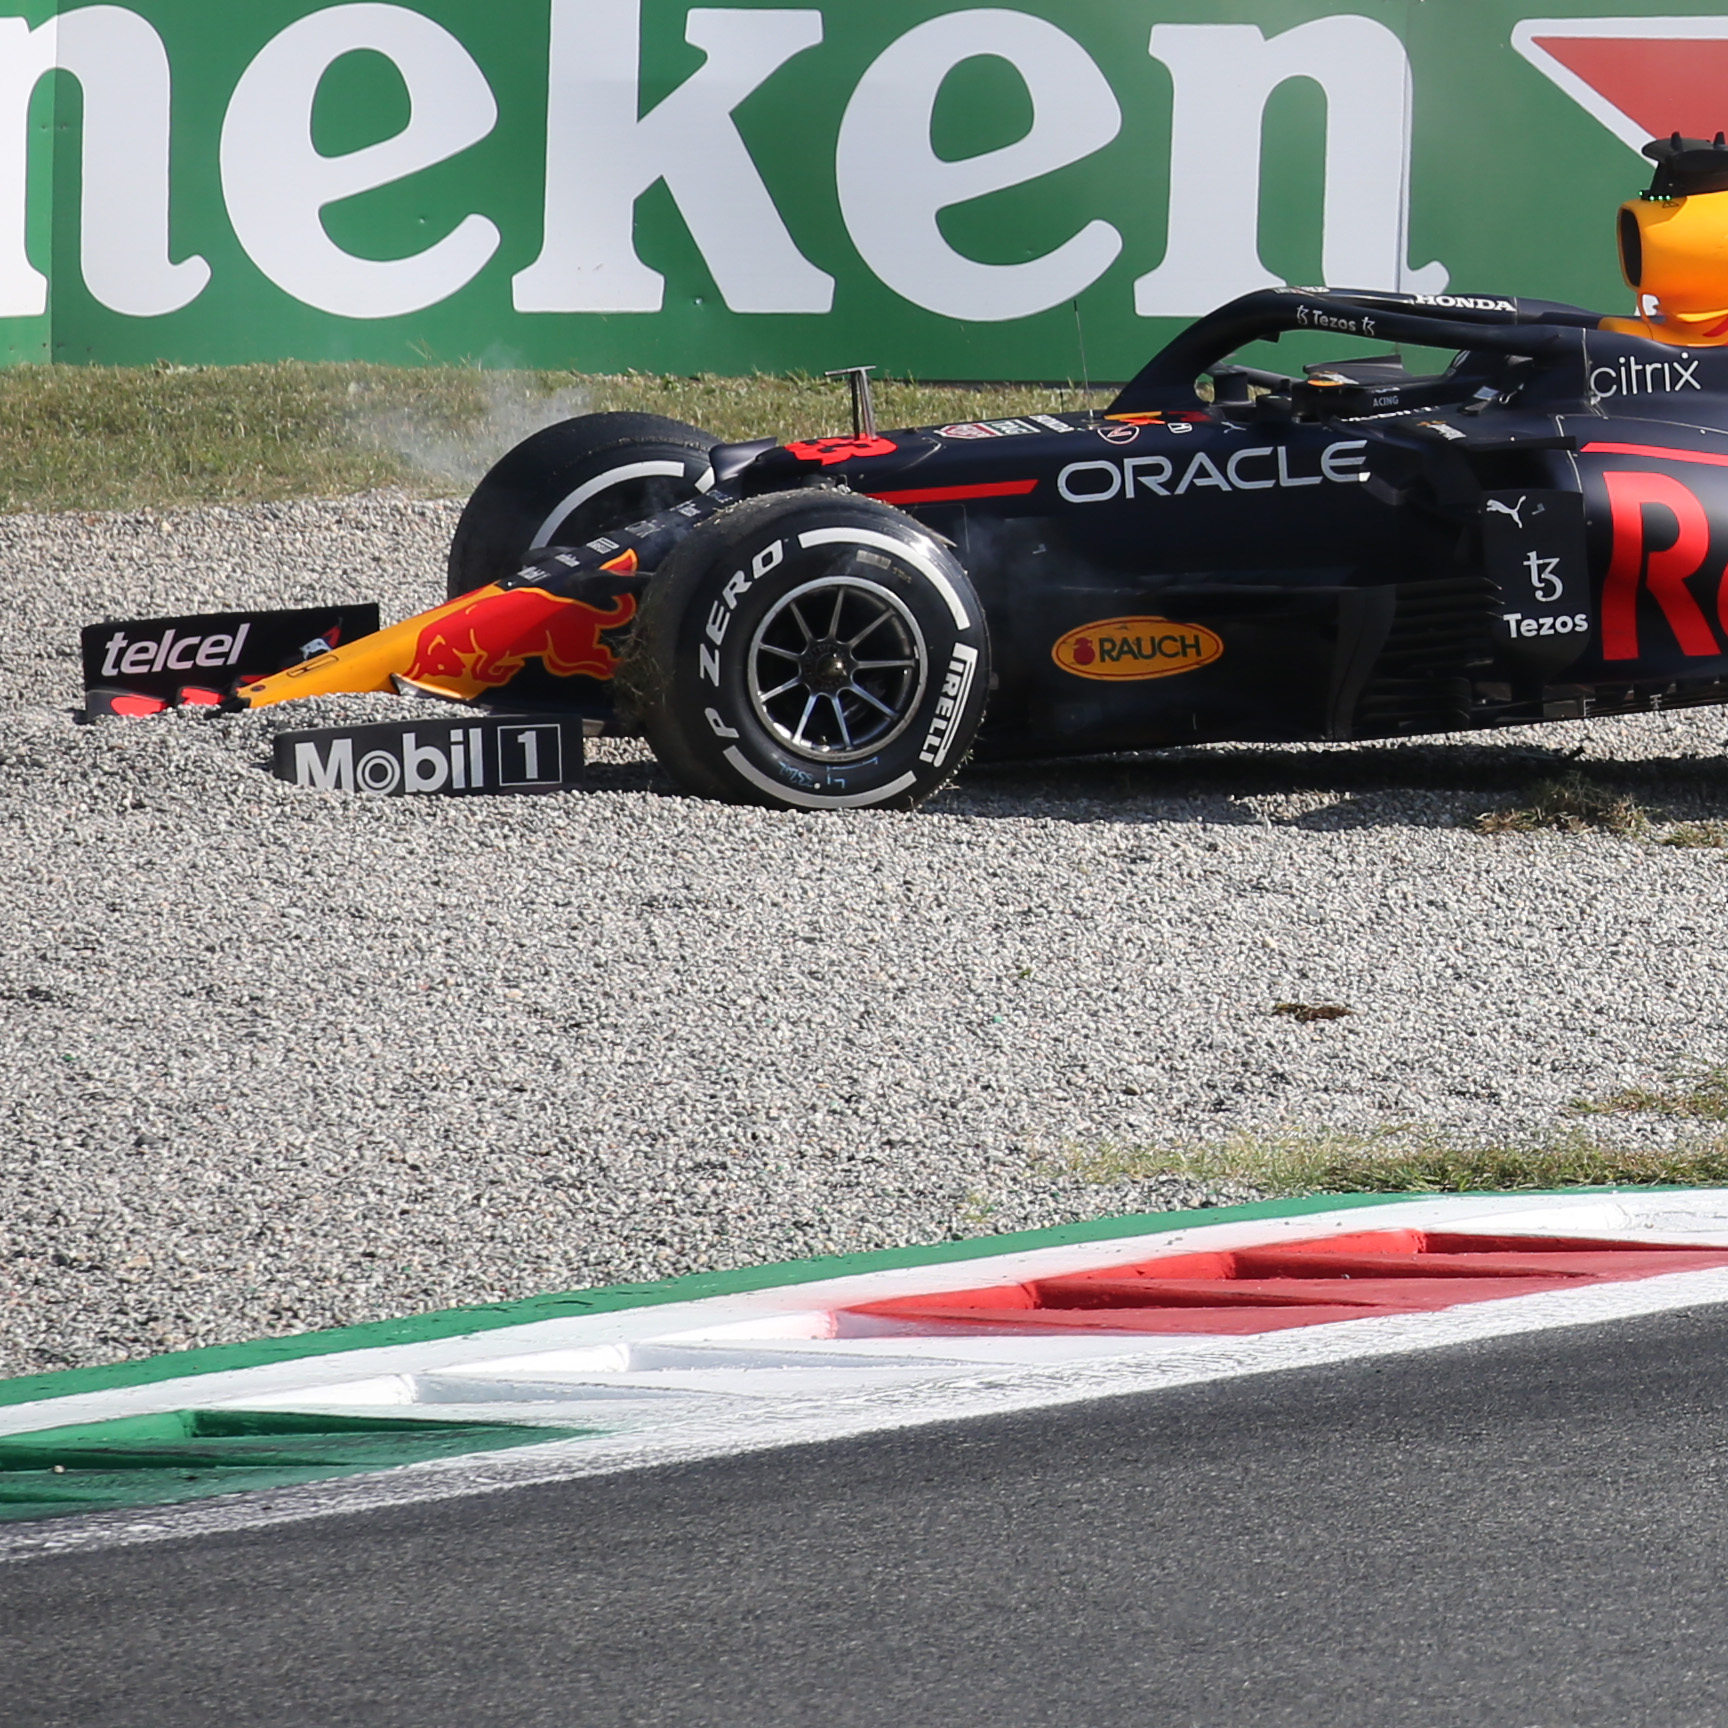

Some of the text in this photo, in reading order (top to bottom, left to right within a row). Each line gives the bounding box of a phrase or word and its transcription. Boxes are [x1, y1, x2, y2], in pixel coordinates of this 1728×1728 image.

[1313, 310, 1357, 332] Tezos
[1411, 293, 1517, 313] HONDA
[1589, 351, 1702, 401] citrix
[1056, 439, 1371, 505] ORACLE
[699, 539, 785, 687] ZERO
[1503, 610, 1589, 639] Tezos
[101, 623, 251, 677] telcel
[1098, 634, 1203, 664] RAUCH
[918, 641, 979, 769] PIRELLI
[294, 726, 539, 796] Mobil 1
